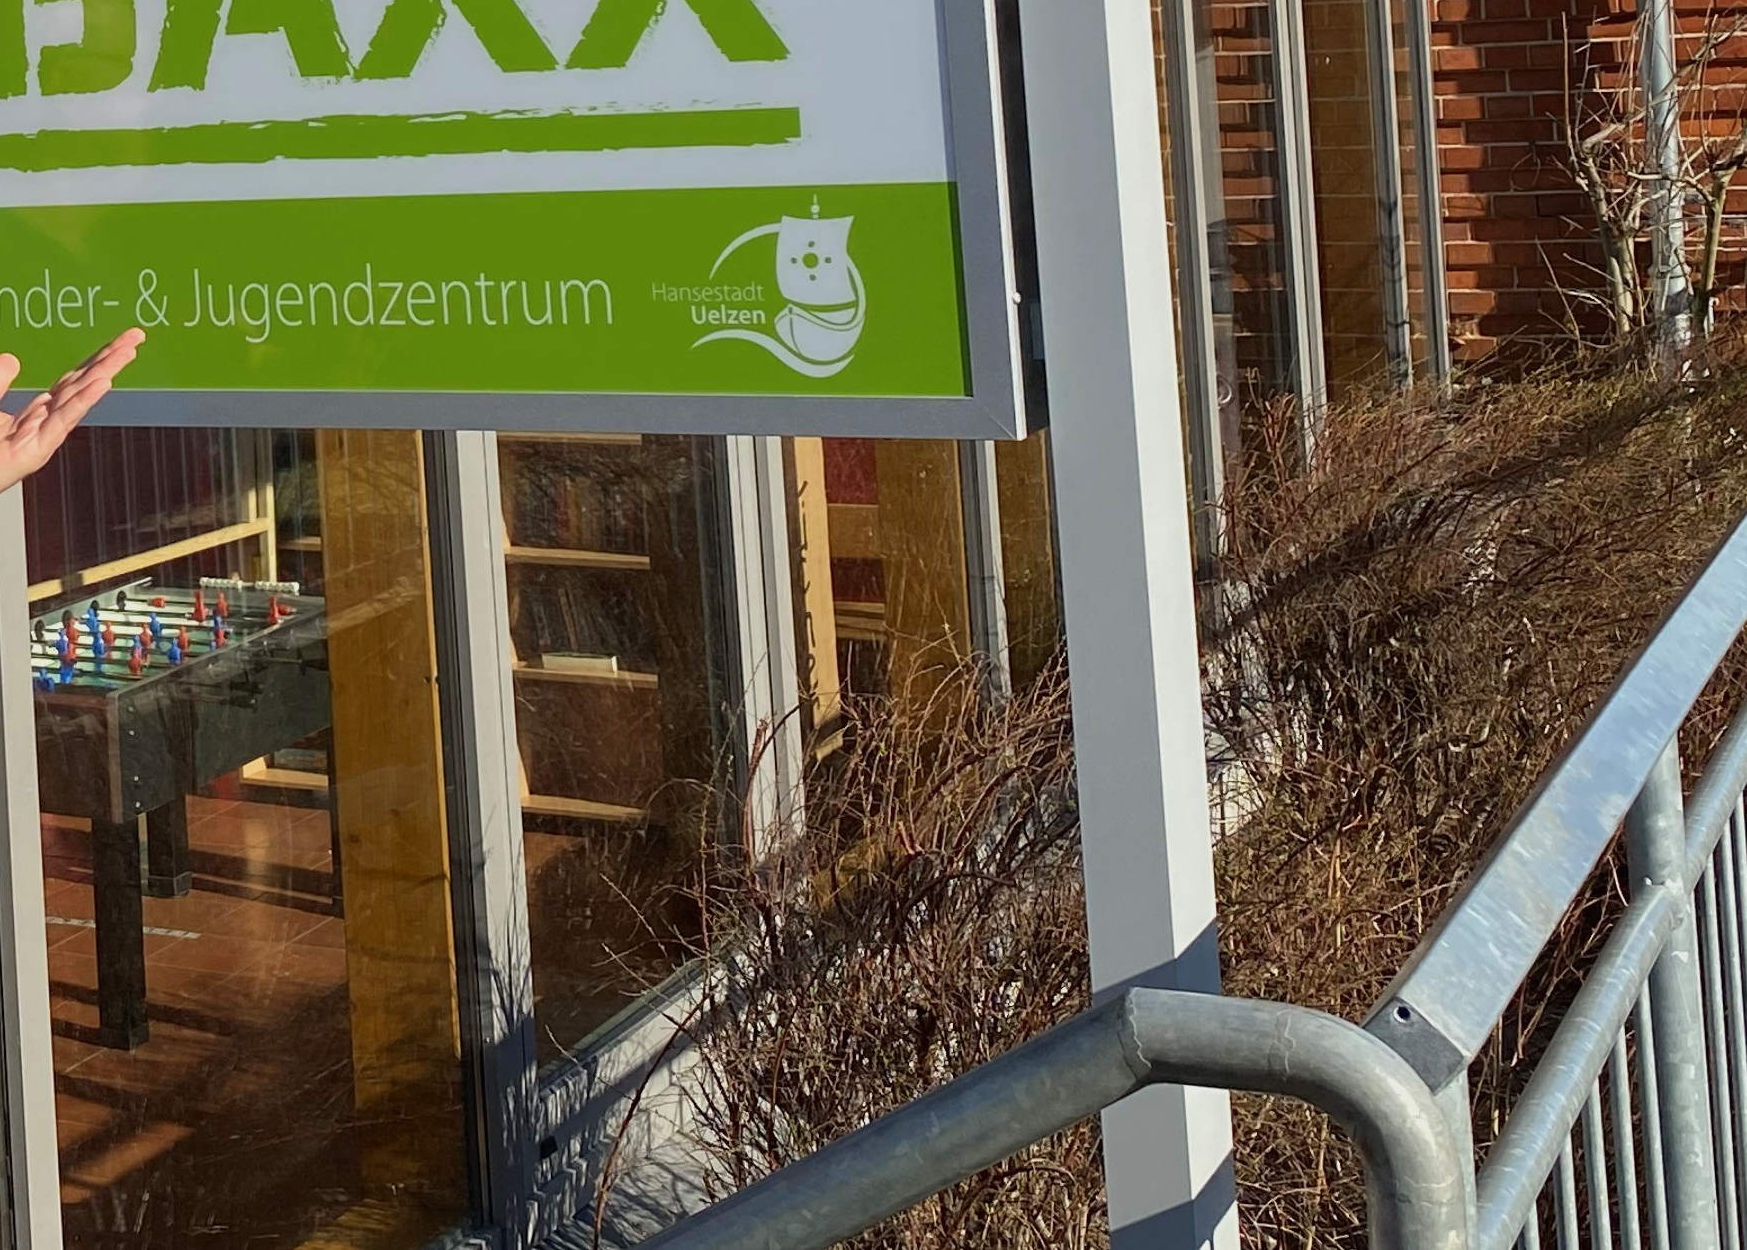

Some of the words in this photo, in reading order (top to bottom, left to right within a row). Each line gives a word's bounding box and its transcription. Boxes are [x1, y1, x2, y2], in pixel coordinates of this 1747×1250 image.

[134, 268, 170, 327] &
[183, 262, 614, 344] Jugendzentrum
[652, 281, 765, 304] Hansestadt
[691, 304, 766, 325] Uelzen
